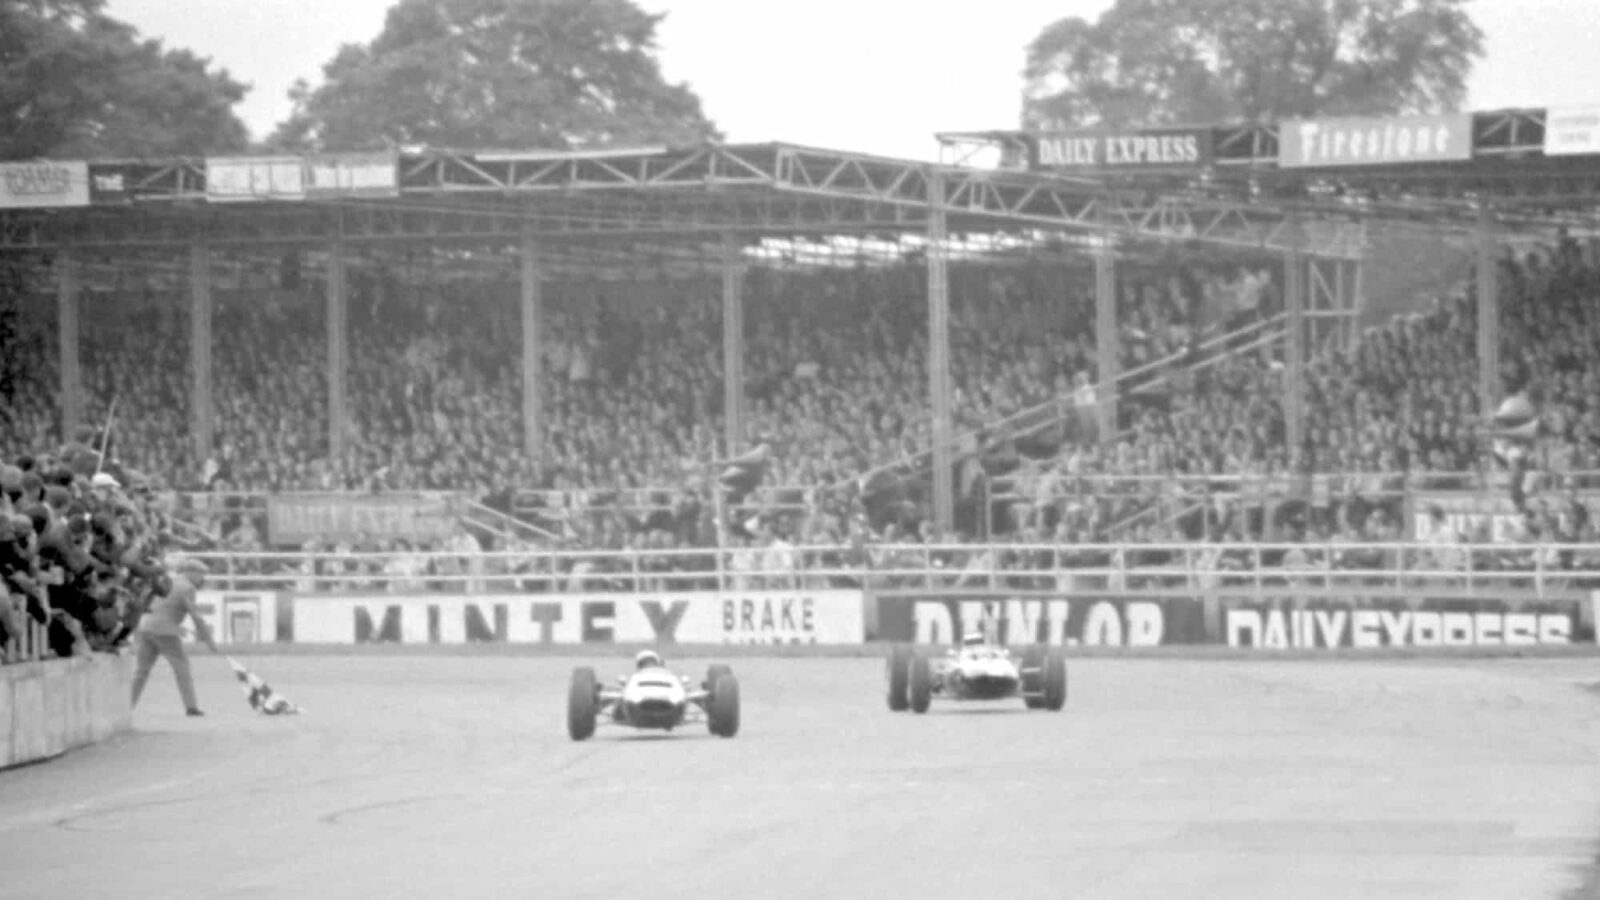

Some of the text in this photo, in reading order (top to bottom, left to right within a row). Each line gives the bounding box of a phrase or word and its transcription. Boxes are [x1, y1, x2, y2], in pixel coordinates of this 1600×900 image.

[1038, 134, 1199, 166] DAILY EXPRESS
[1300, 120, 1450, 163] Firestone
[722, 597, 817, 632] BRAKE
